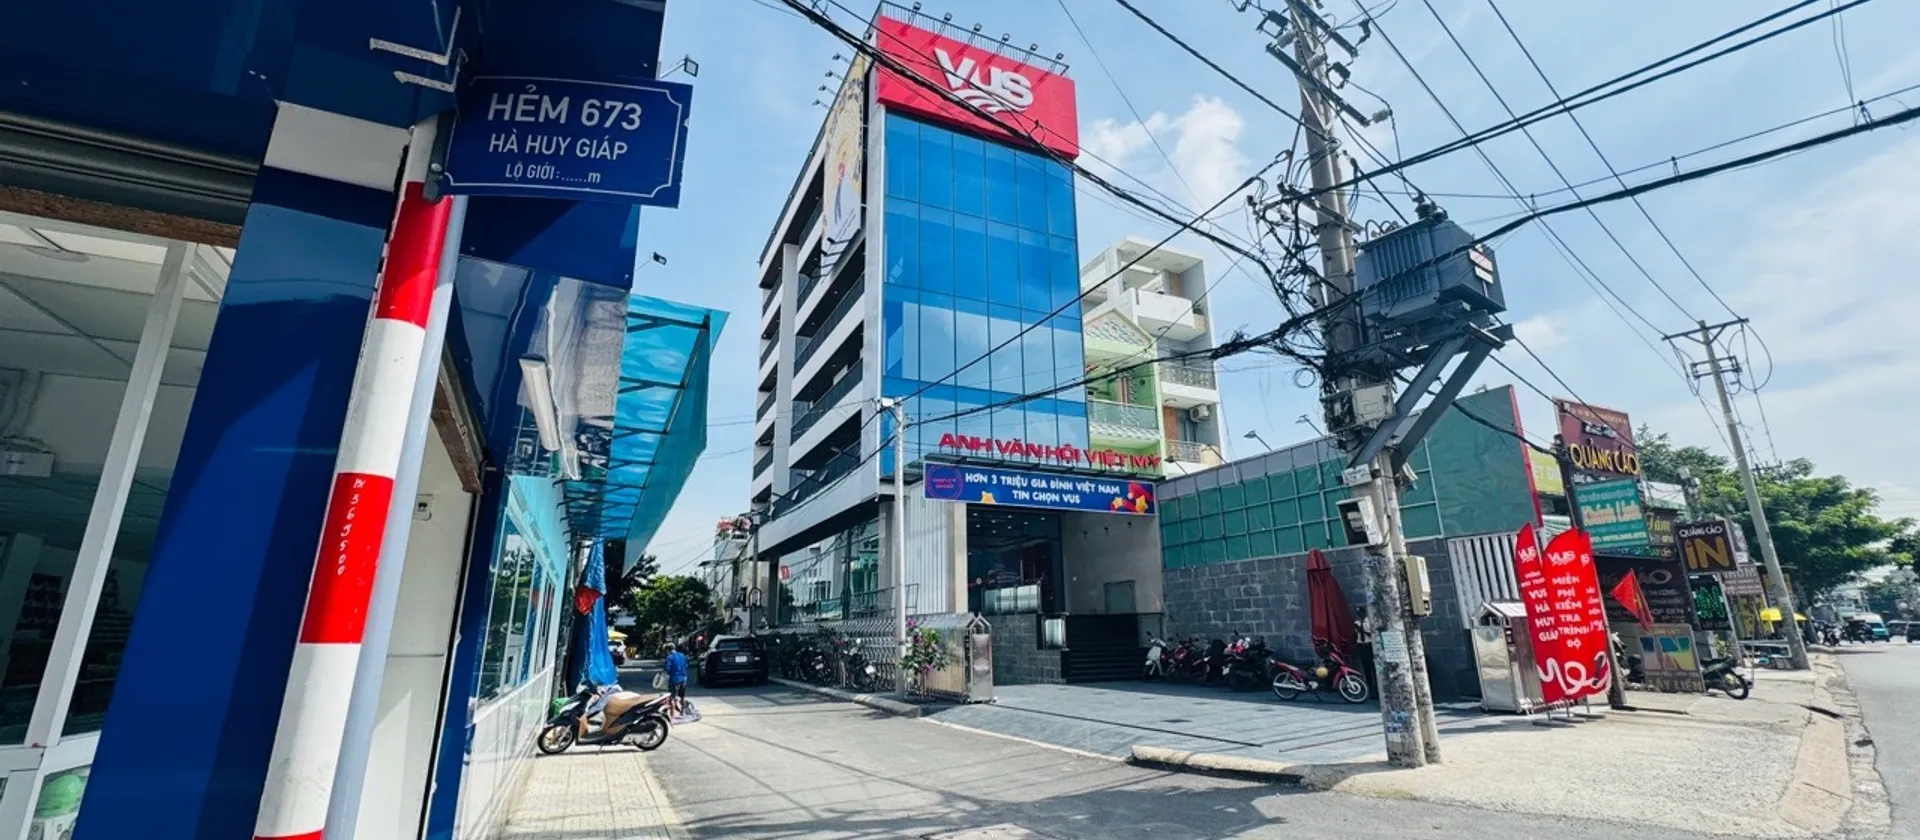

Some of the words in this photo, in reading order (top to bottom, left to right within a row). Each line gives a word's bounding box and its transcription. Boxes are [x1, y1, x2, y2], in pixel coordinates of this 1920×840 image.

[934, 47, 1034, 107] VUS
[487, 83, 570, 124] HẺM
[580, 98, 642, 131] 673
[489, 127, 519, 154] HÀ
[525, 133, 571, 156] HUY
[576, 135, 628, 160] GIÁP
[505, 161, 524, 181] LỘ
[939, 433, 993, 453] ANH
[995, 437, 1043, 459] VĂN
[1045, 443, 1080, 464] HỘI
[1083, 448, 1128, 467] VIỆT
[1614, 444, 1640, 475] CÁO
[965, 472, 988, 483] HƠN
[991, 474, 998, 484] 3
[1000, 475, 1028, 489] TRIỆU
[1030, 478, 1048, 488] GIA
[1050, 478, 1073, 490] ĐÌNH
[1075, 481, 1096, 494] VIỆT
[1098, 485, 1120, 494] NAM
[1012, 490, 1030, 500] TIN
[1032, 491, 1060, 504] CHỌN
[1062, 493, 1081, 504] VUS
[1547, 550, 1576, 562] VUS
[1557, 586, 1576, 597] PHÍ
[1535, 600, 1550, 613] HÀ
[1555, 597, 1583, 610] KIỂM
[1535, 616, 1555, 628] HUY
[1559, 613, 1581, 622] TRA
[1557, 625, 1589, 635] TRÌNH
